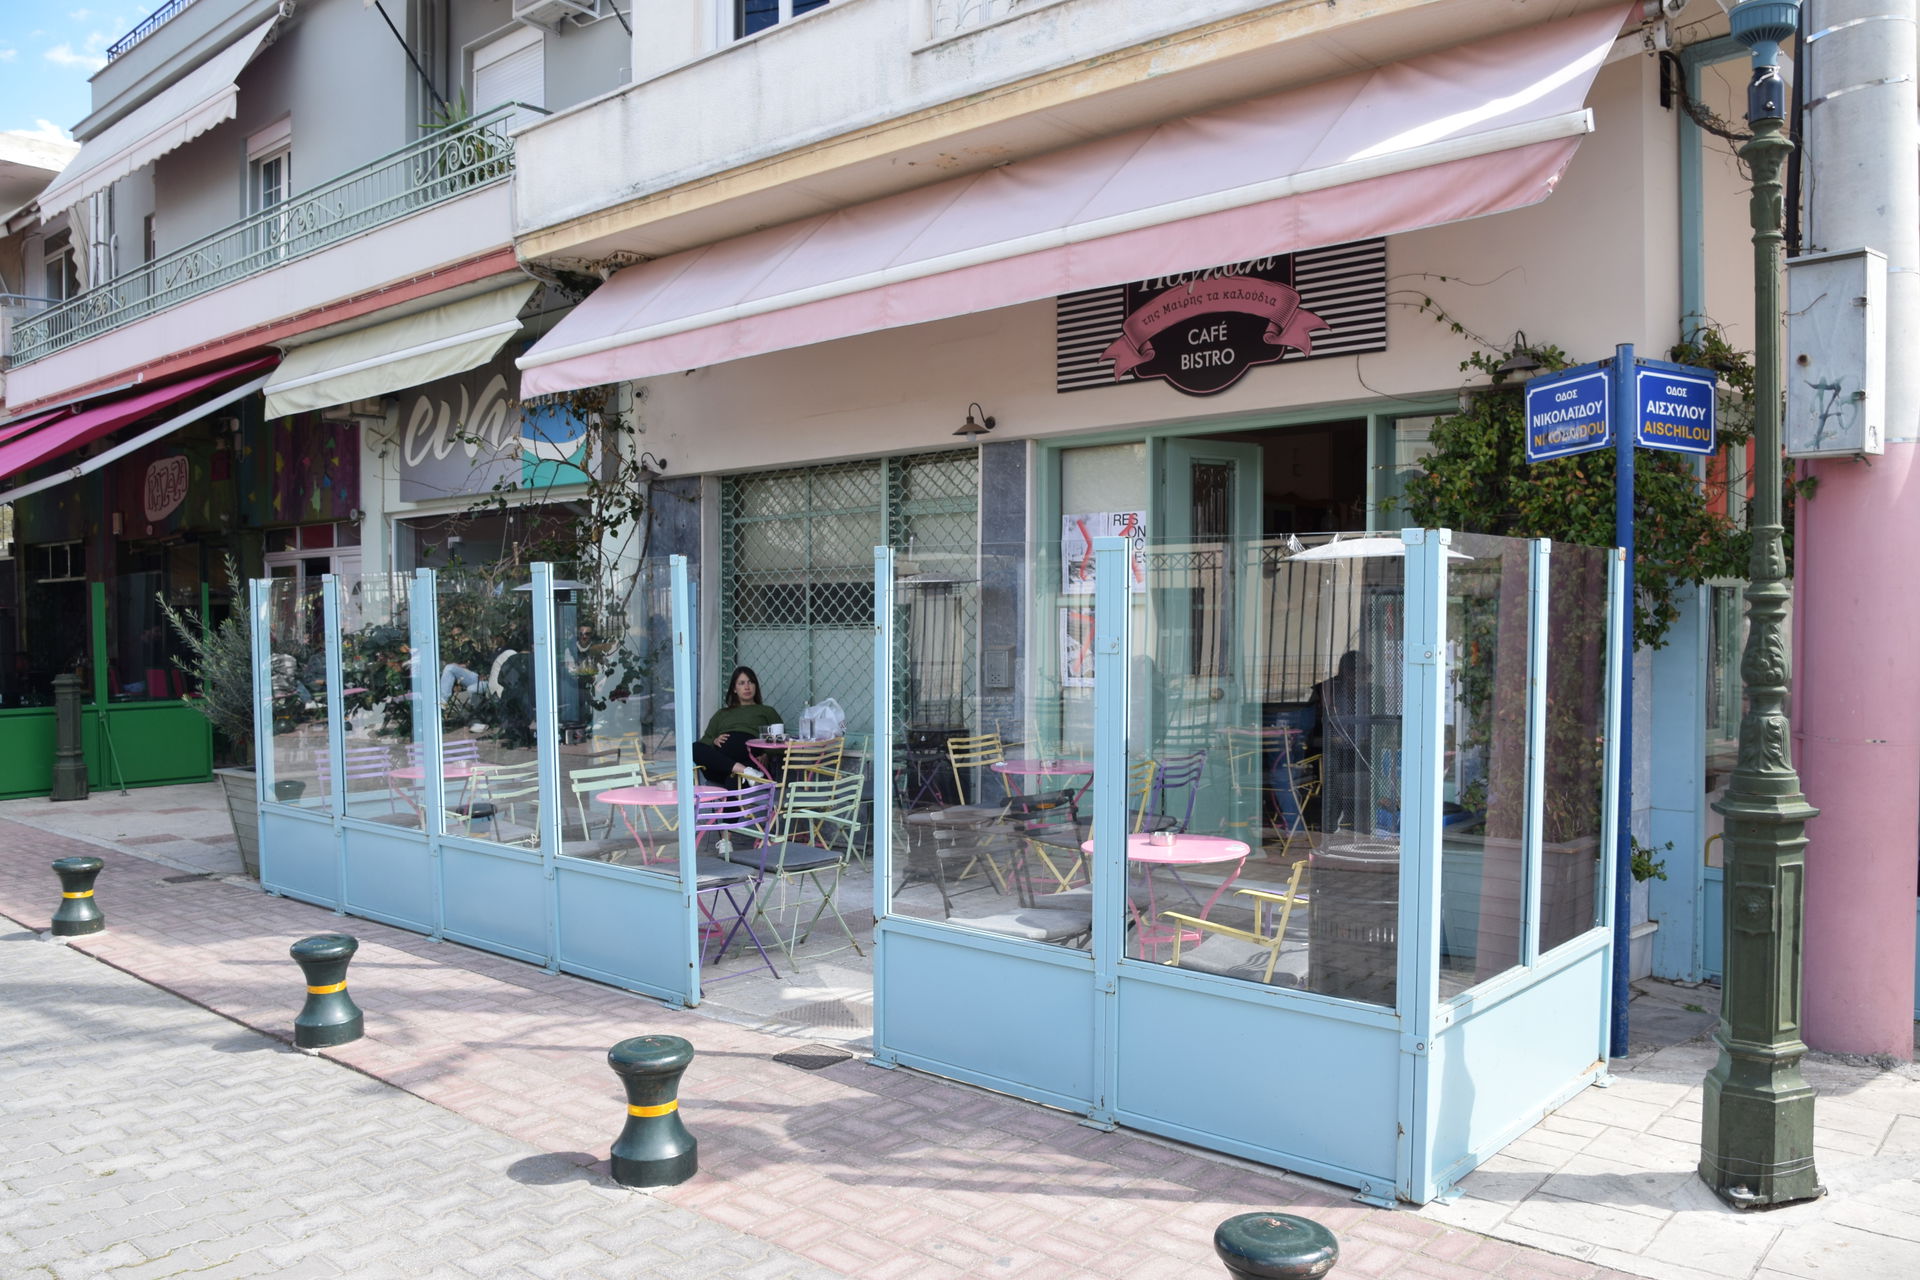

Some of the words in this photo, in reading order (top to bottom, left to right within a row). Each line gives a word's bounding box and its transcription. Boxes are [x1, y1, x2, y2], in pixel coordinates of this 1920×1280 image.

[1141, 310, 1161, 326] της
[1206, 292, 1220, 302] τα
[1223, 288, 1277, 307] καλούδια
[1187, 321, 1228, 346] CAFÉ
[1180, 348, 1235, 370] BISTRO
[1555, 389, 1578, 402] ΟΔΟΣ
[1665, 385, 1688, 398] ΟΔΟΣ
[1646, 399, 1707, 421] ΑΙΣΧΥΛΟΥ
[1643, 420, 1710, 441] AISCHILOU
[1113, 512, 1139, 526] RES
